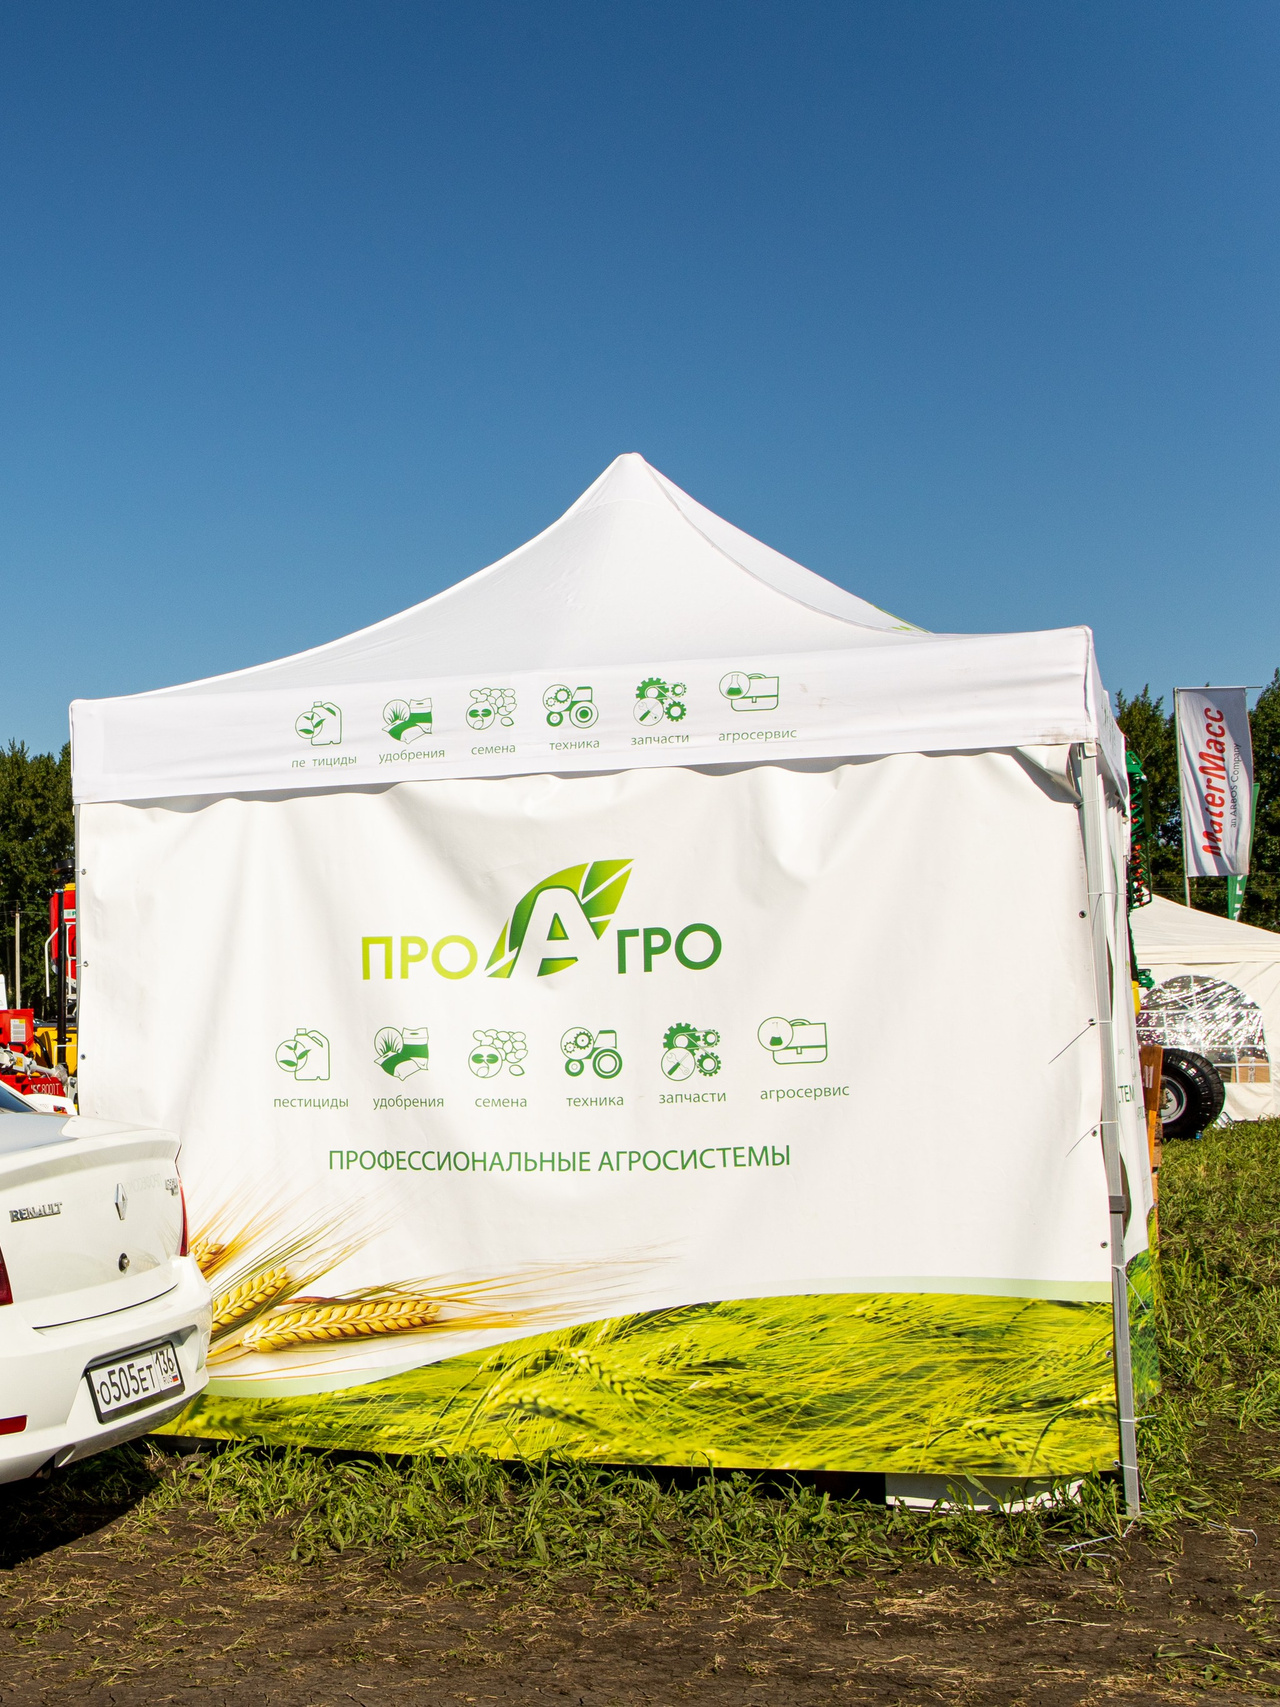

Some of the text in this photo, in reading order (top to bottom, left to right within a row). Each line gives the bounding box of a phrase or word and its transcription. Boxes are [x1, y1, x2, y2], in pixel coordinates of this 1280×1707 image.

[378, 748, 445, 765] удобрения
[470, 744, 516, 755] семена
[549, 740, 600, 751] техника
[631, 734, 690, 746] запчасти
[718, 729, 797, 745] агросервис
[1230, 742, 1242, 783] Company
[1198, 706, 1226, 858] MaterMacc
[273, 1085, 850, 1112] пестициды удобрения семена техника запчасти агросервис
[328, 1144, 791, 1175] ПРОФЕССИОНАЛЬНЫЕ АГРОСИСТЕМЫ
[8, 1202, 63, 1223] RENAULT
[155, 1349, 175, 1375] 136
